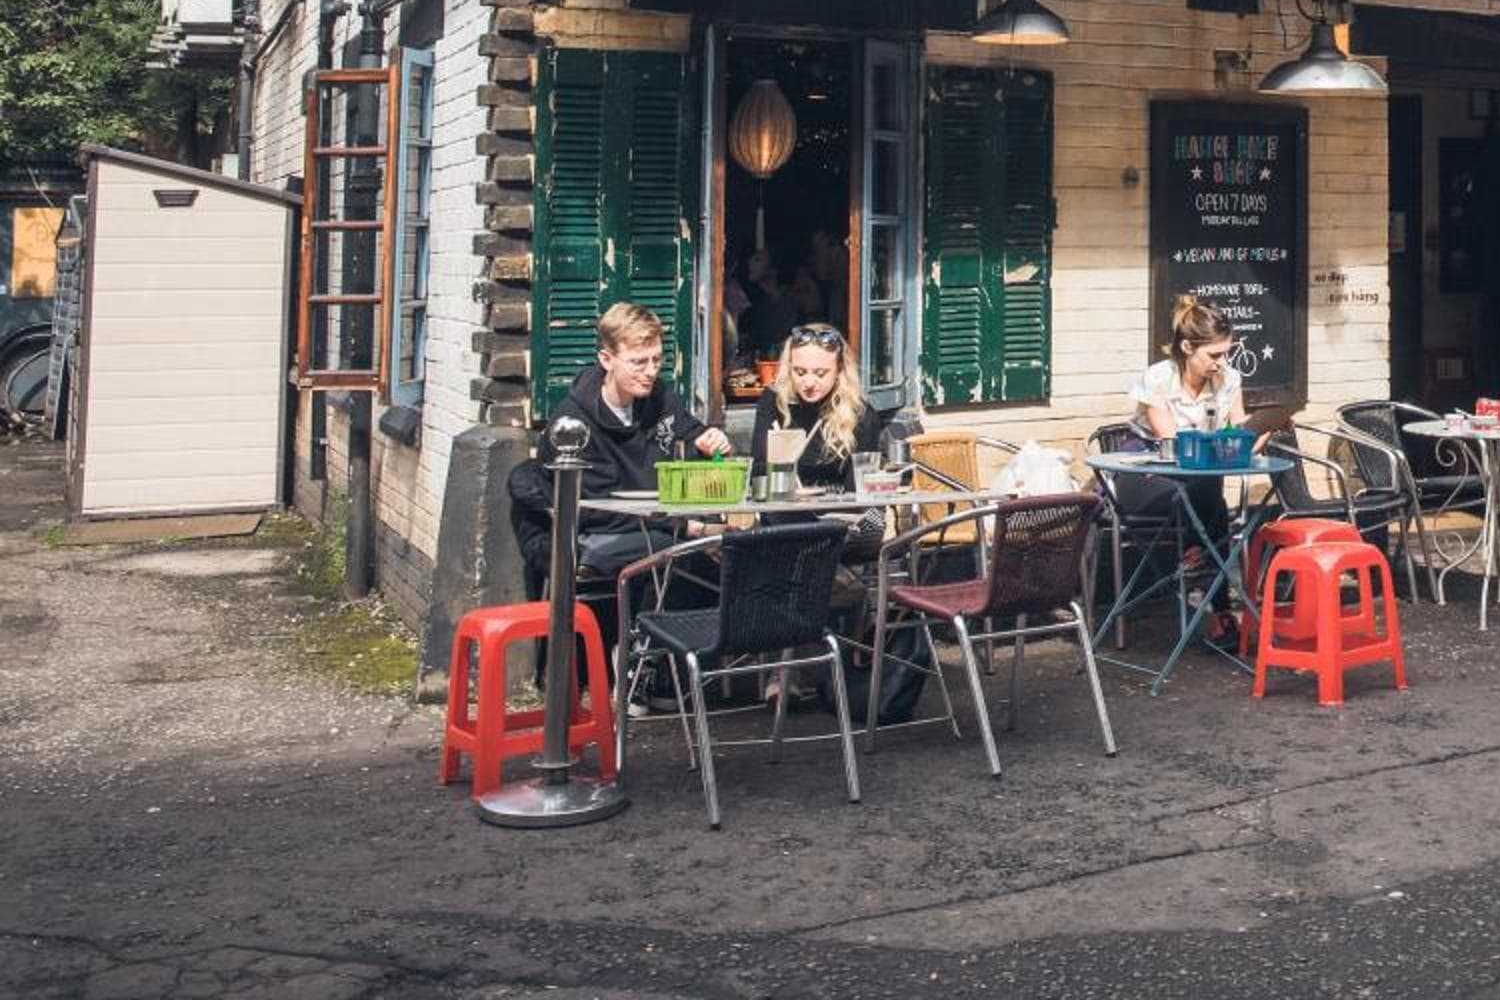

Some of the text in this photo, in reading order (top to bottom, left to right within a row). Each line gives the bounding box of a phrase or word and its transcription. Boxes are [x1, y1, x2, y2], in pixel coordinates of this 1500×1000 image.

[1195, 193, 1267, 213] OPEN 7 DAYS
[1184, 247, 1216, 263] VEGAN
[1218, 247, 1235, 262] AND
